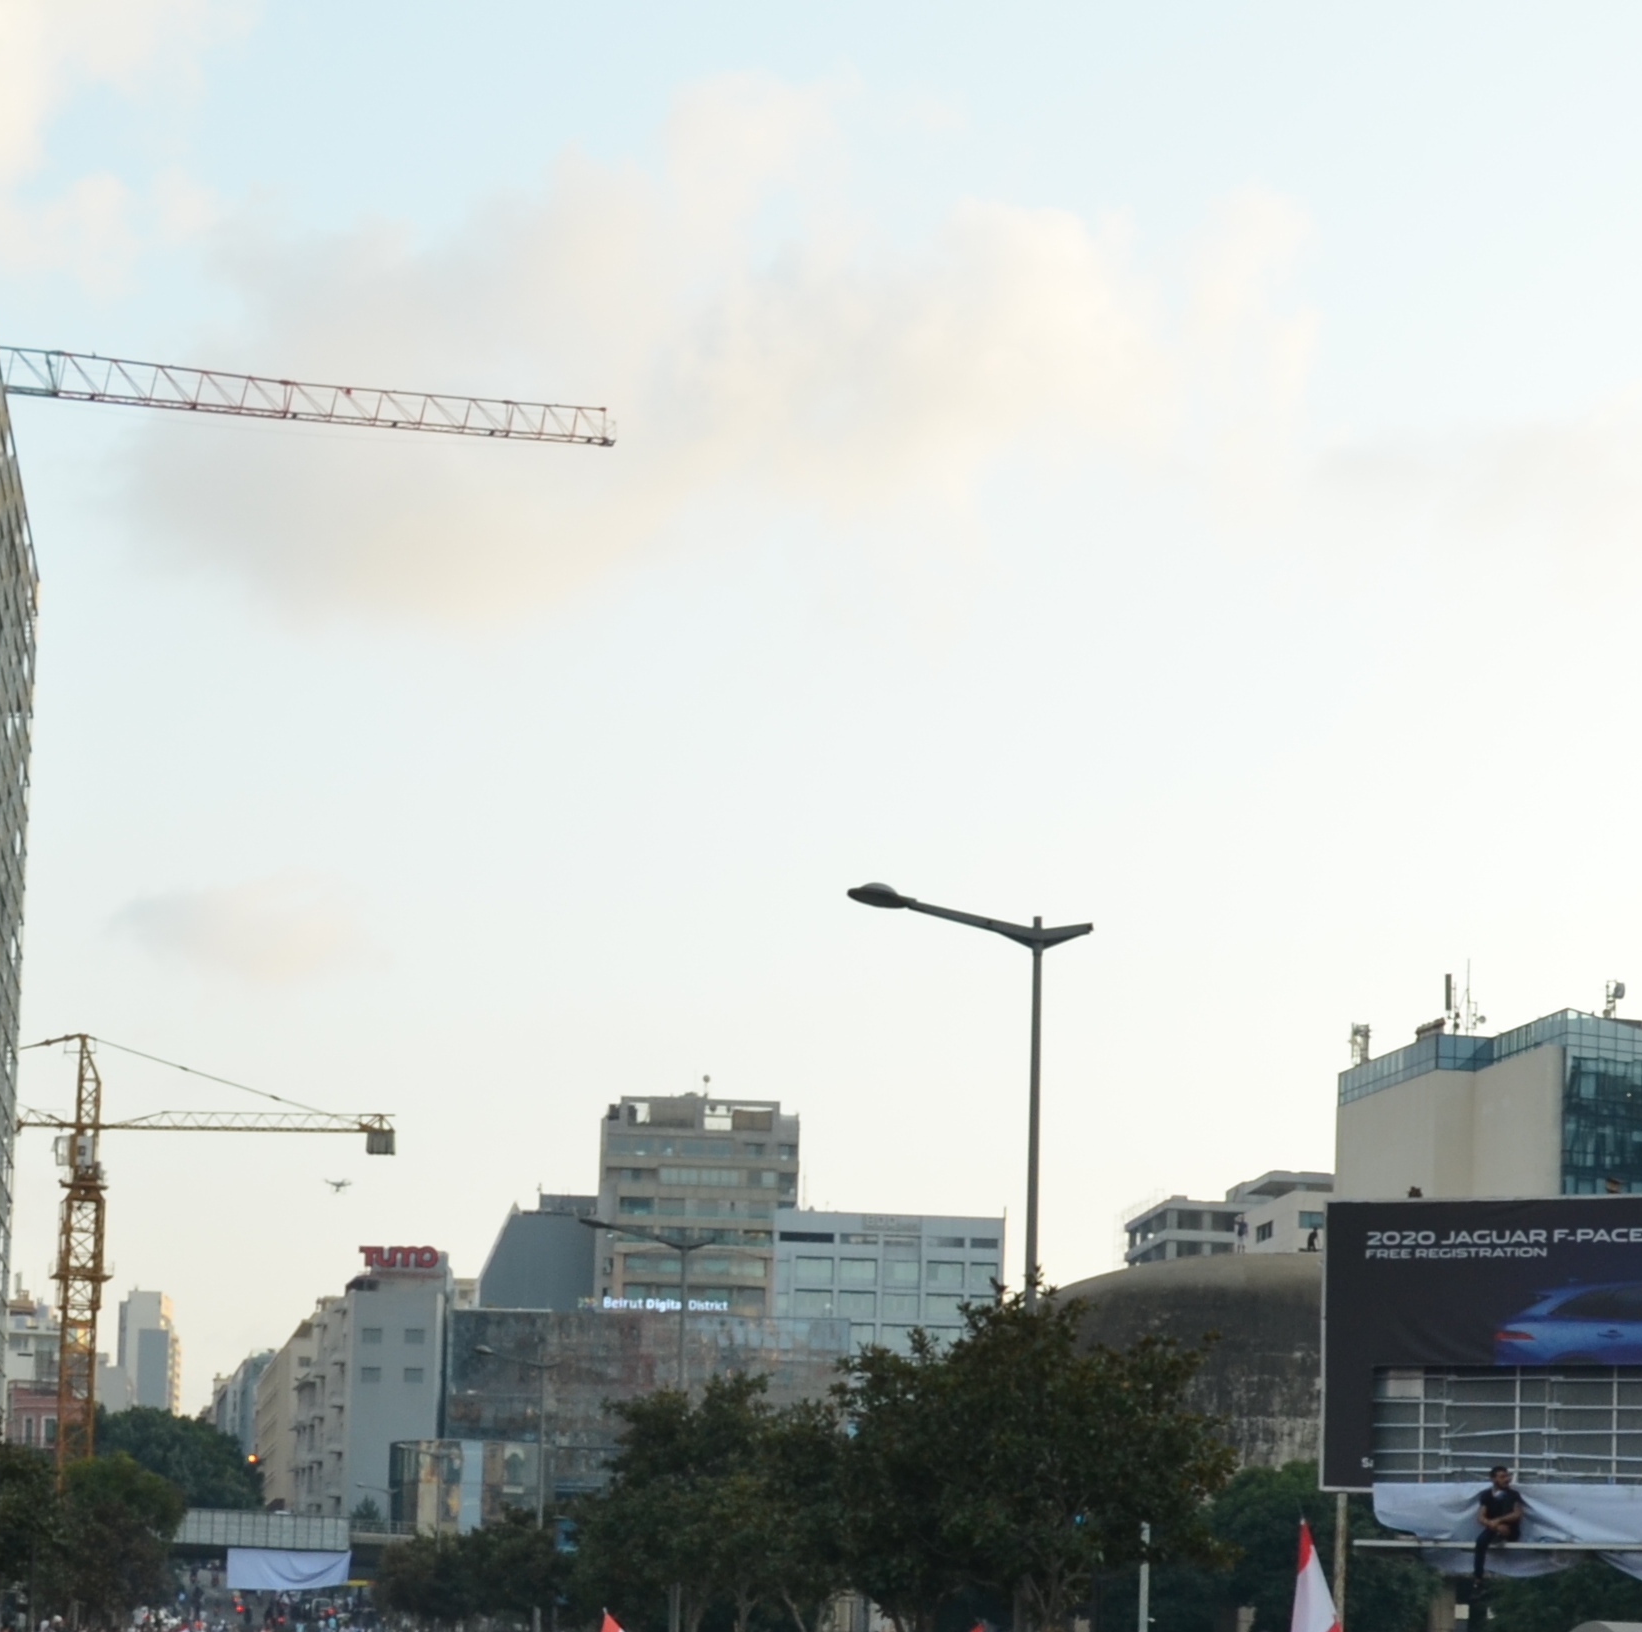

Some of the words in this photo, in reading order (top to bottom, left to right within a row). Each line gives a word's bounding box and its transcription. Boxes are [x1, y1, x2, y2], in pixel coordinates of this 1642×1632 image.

[1366, 1231, 1436, 1246] 2020
[1441, 1230, 1548, 1245] JAGUAR
[359, 1246, 438, 1268] TUMO
[1365, 1248, 1412, 1259] FREE
[1415, 1247, 1547, 1259] REGISTRATION
[603, 1296, 644, 1310] Beirut
[646, 1299, 682, 1313] Digita
[688, 1299, 728, 1311] District
